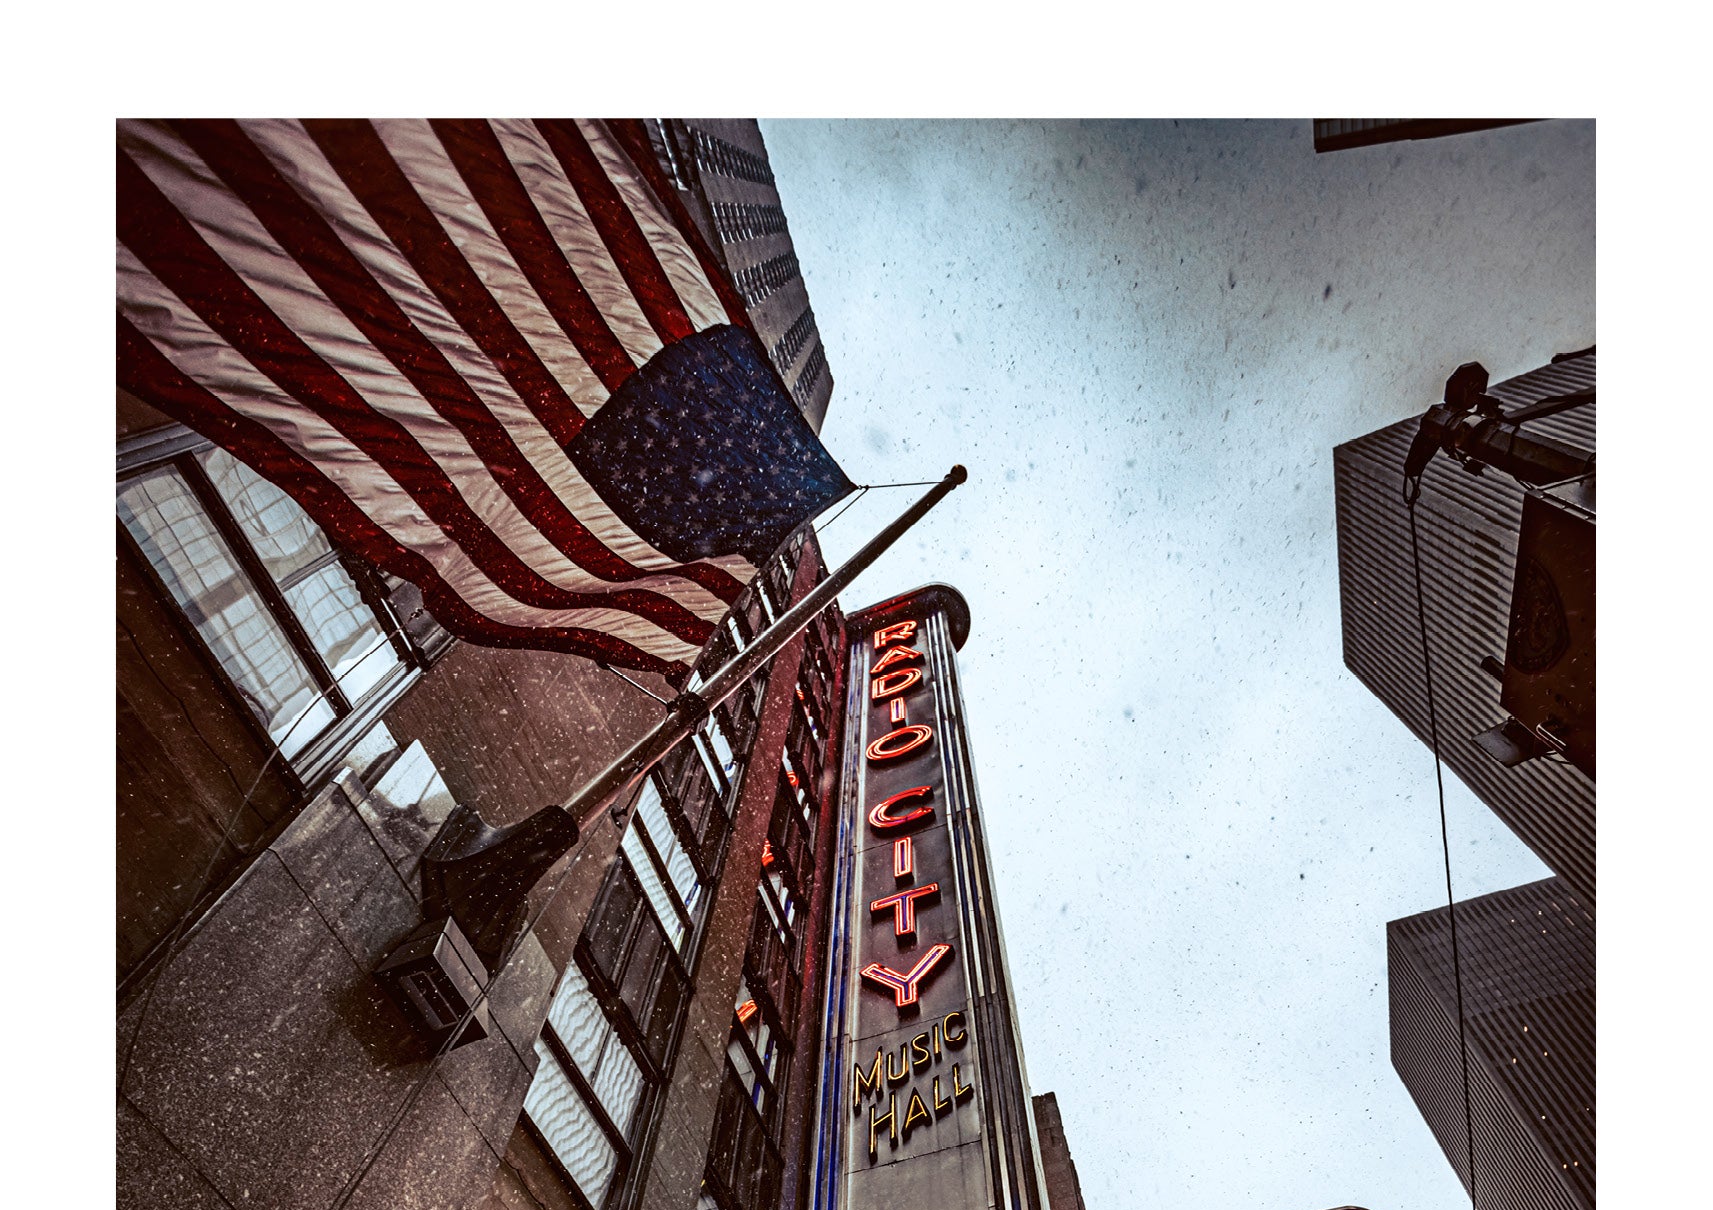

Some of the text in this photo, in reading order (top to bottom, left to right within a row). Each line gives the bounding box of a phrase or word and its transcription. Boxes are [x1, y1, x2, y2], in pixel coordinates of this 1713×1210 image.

[860, 620, 953, 1008] RADIO CITY
[854, 1012, 966, 1108] MUSIC
[869, 1064, 971, 1156] HALL
